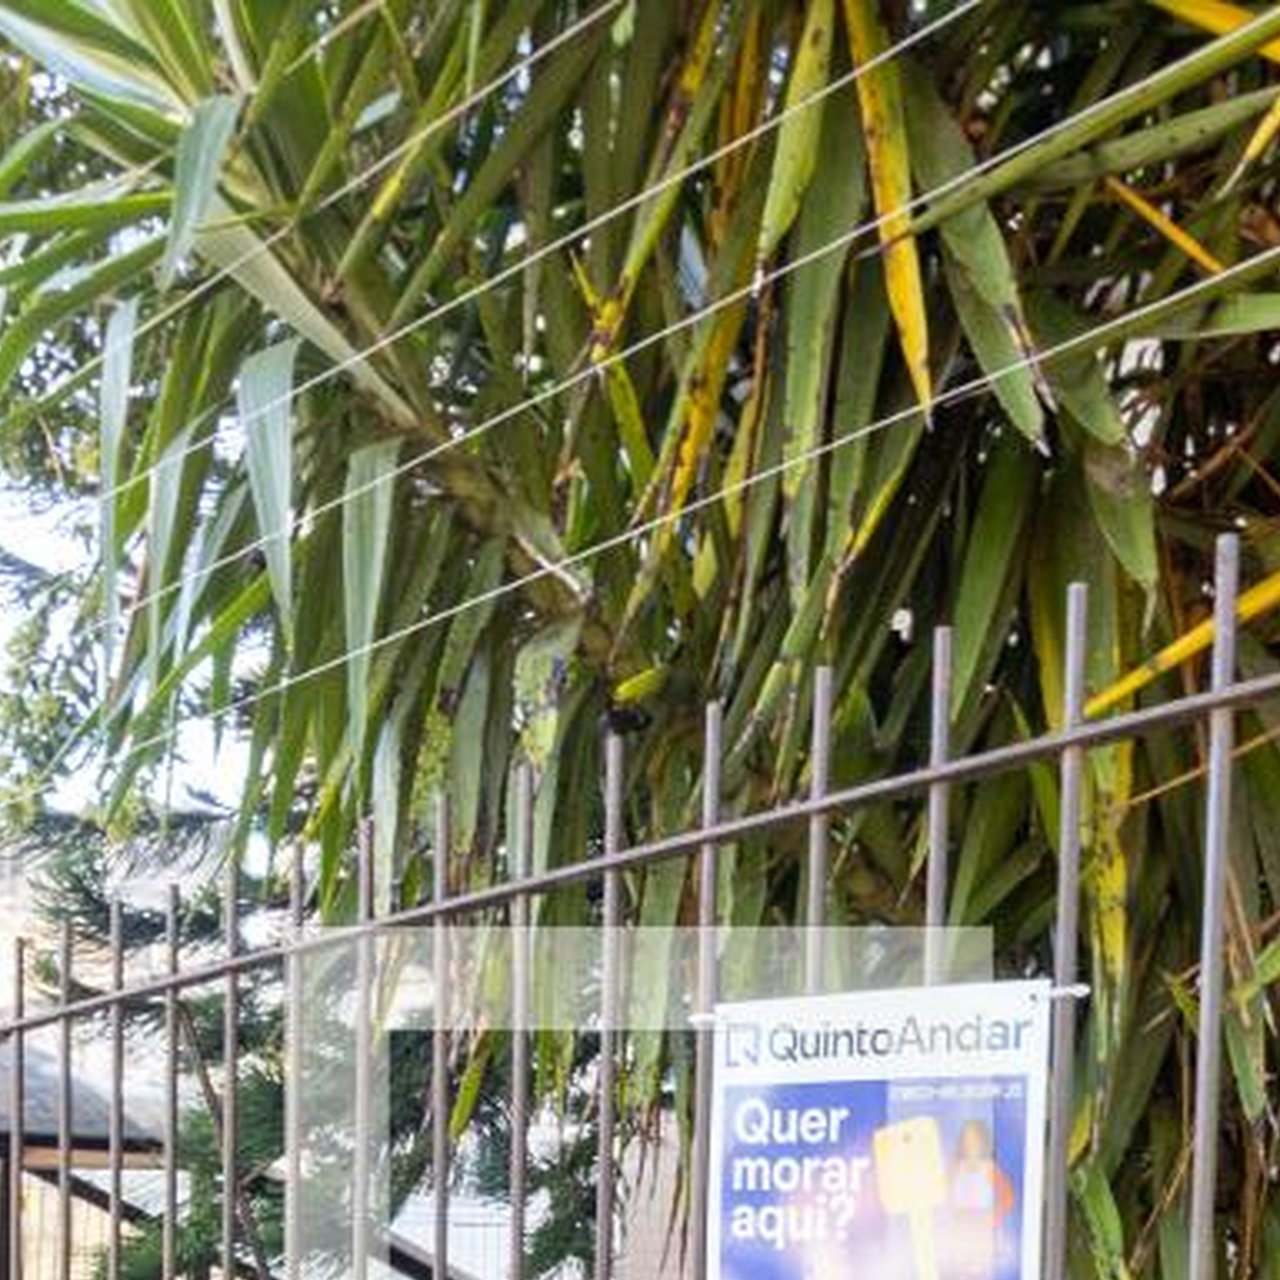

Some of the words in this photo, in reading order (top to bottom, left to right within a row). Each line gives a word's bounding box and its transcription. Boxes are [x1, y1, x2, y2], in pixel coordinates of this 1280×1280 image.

[769, 1014, 1032, 1063] QuintoAndar
[735, 1098, 851, 1146] Quer
[732, 1156, 871, 1192] morar
[732, 1194, 855, 1250] aqui?
